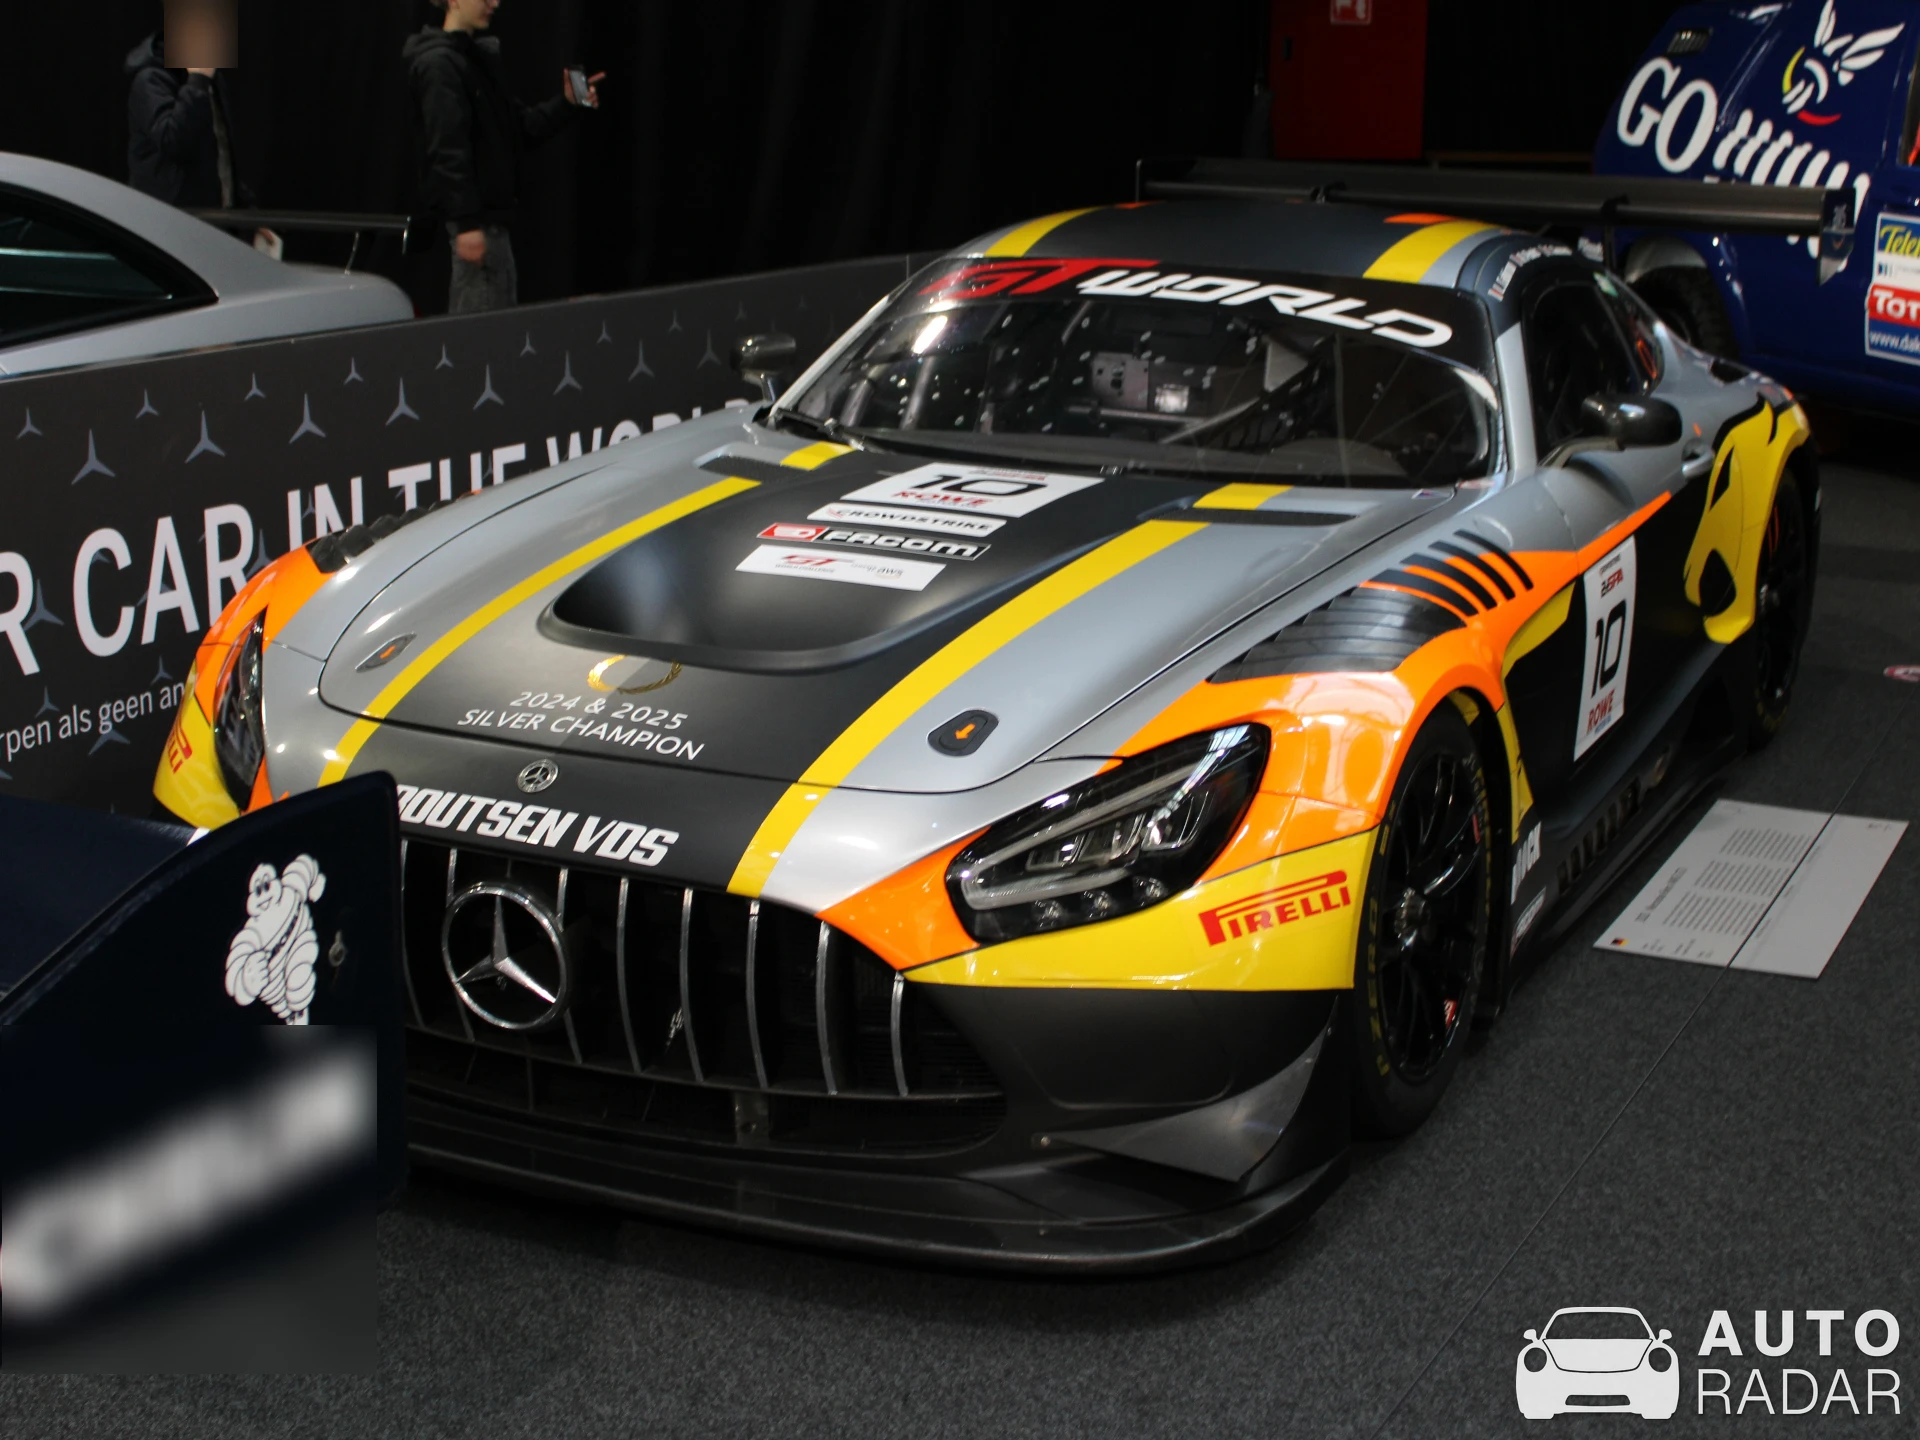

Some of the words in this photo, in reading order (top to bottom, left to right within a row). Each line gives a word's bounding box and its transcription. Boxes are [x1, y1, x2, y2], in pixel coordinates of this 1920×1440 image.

[918, 257, 1160, 297] GT
[1079, 269, 1453, 348] WORLD
[909, 474, 1048, 496] 10
[822, 531, 979, 557] FACOM
[73, 502, 255, 657] CAR
[1591, 599, 1627, 699] 10
[59, 704, 92, 739] als
[99, 691, 153, 735] geen
[457, 708, 546, 731] SILVER
[549, 714, 705, 761] CHAMPION
[510, 691, 583, 711] 2024
[583, 695, 607, 715] &
[611, 702, 689, 730] 2025
[1586, 688, 1615, 735] ROWE
[573, 815, 680, 867] VDS
[1198, 870, 1352, 947] PIRELLI
